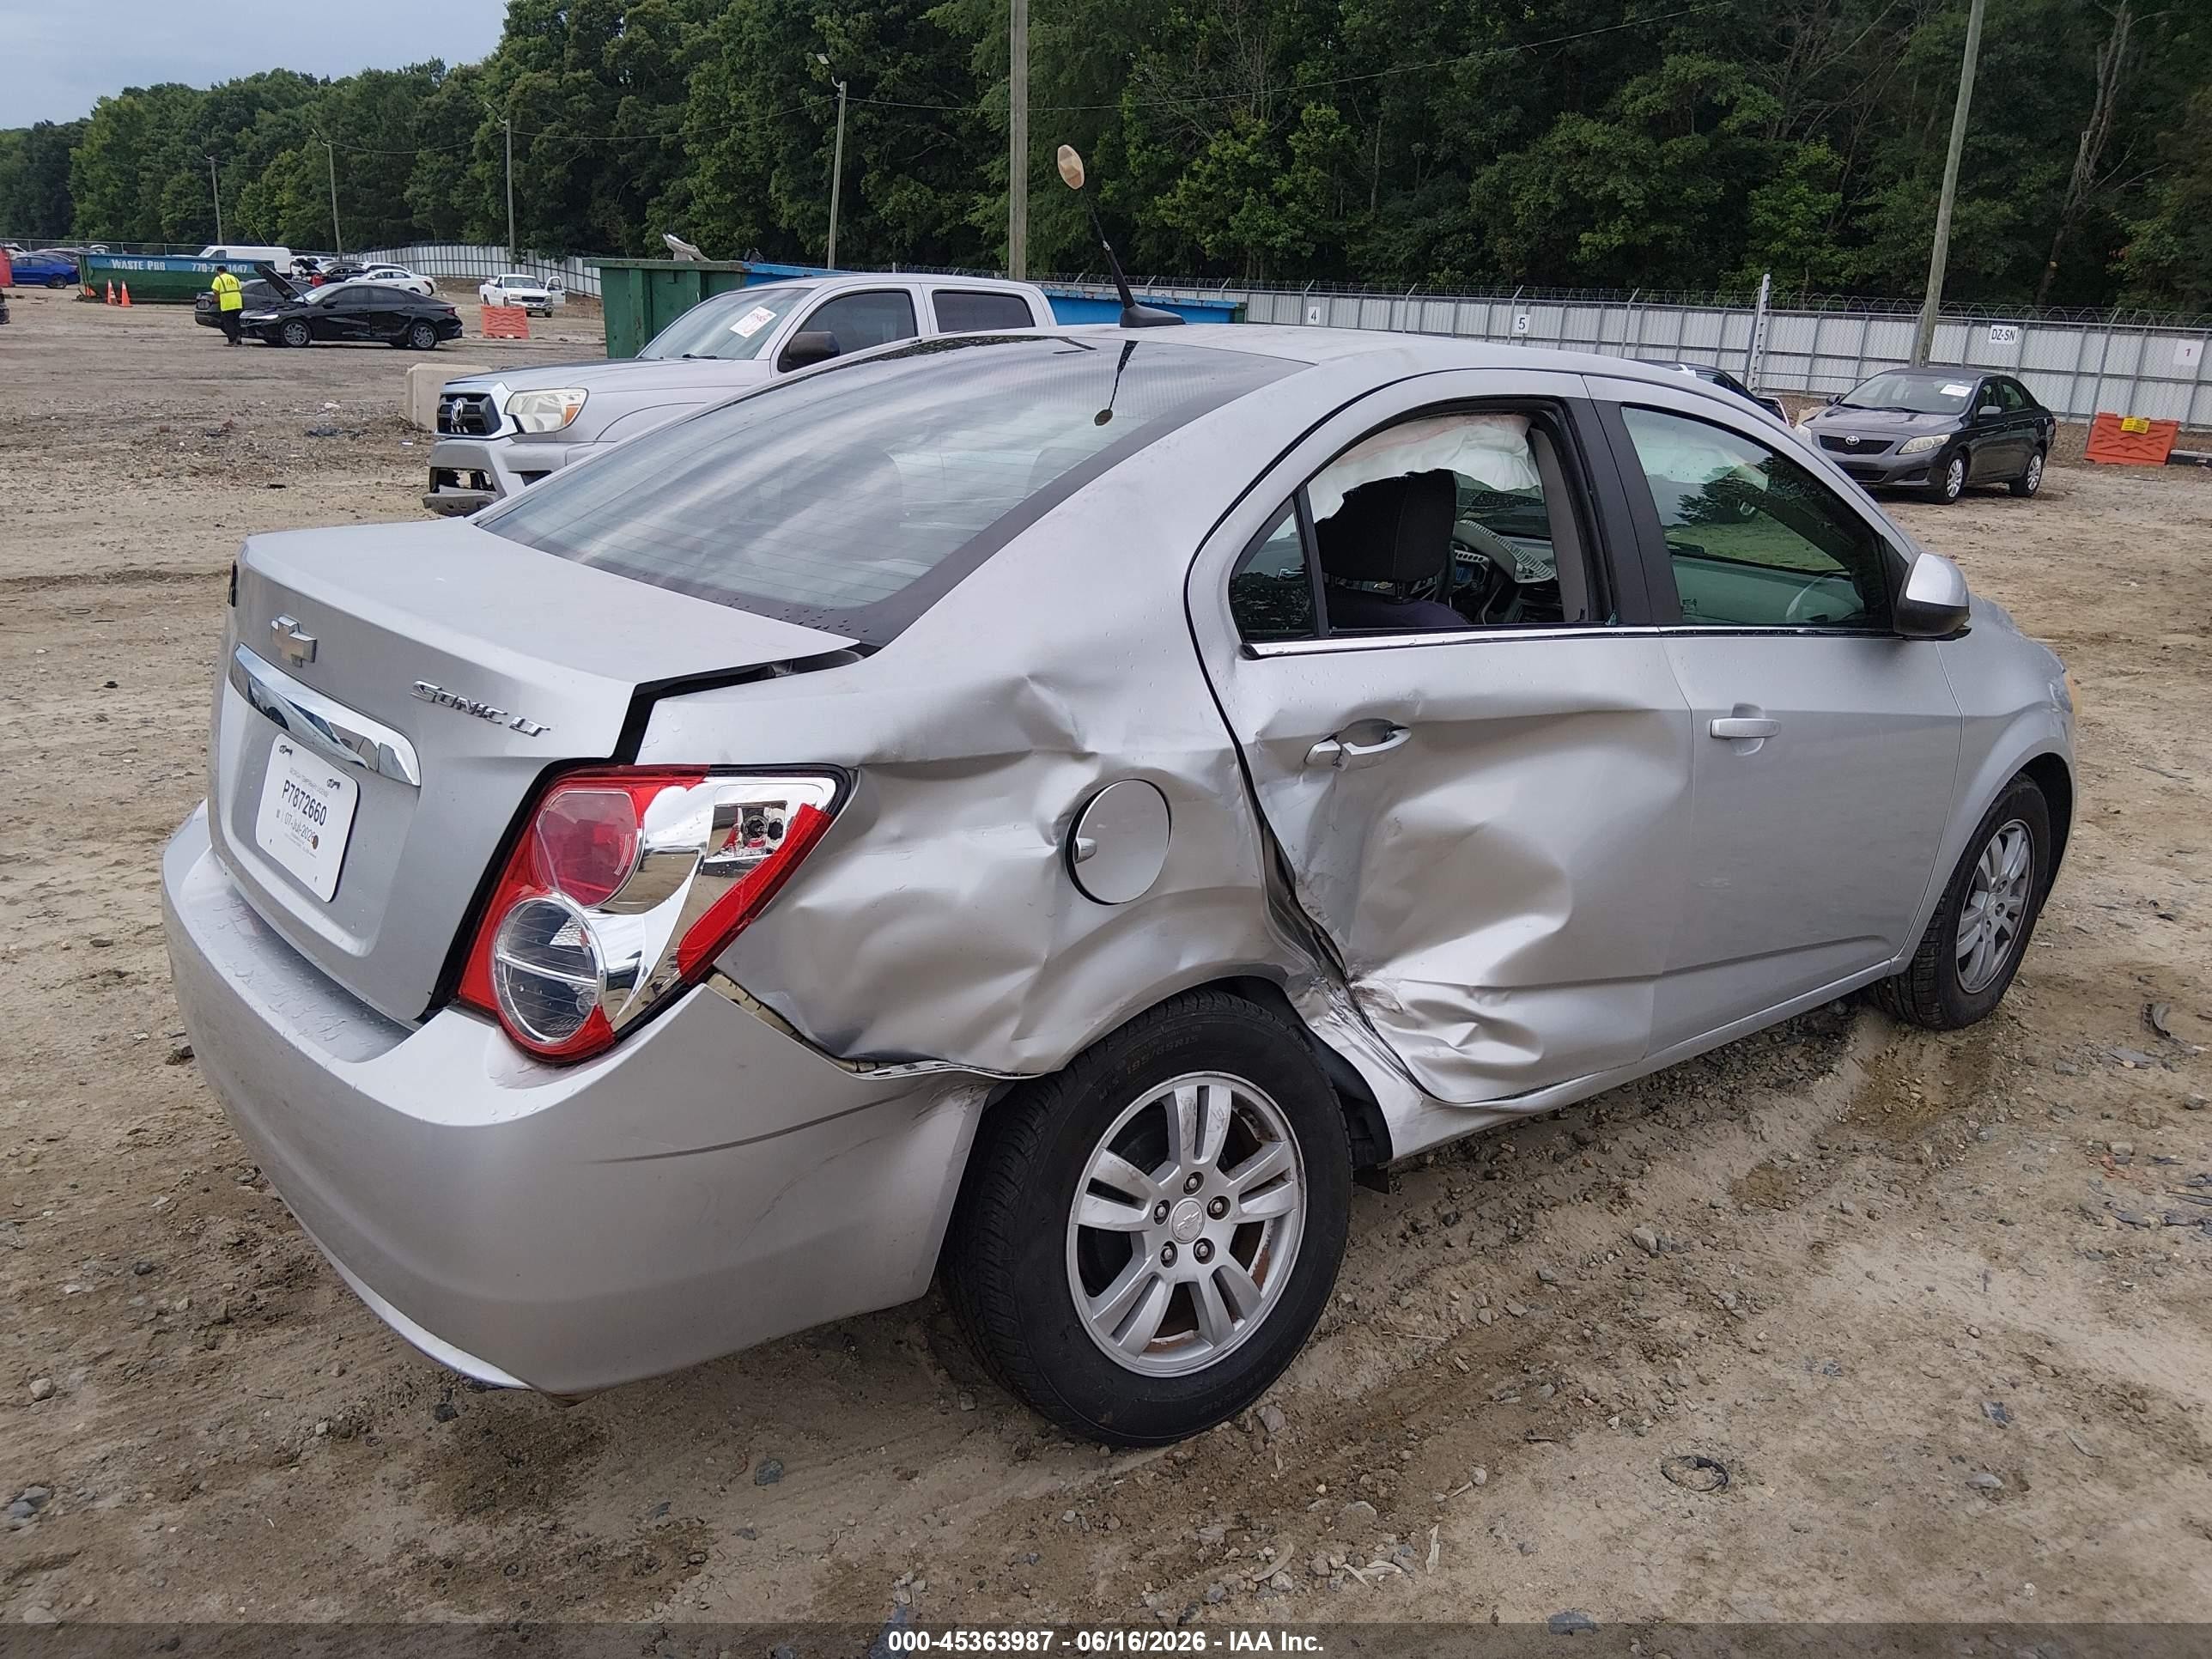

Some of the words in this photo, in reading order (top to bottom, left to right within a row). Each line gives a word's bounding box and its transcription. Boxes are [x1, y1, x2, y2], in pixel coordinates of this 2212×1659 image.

[112, 259, 144, 270] WASTE
[1311, 310, 1317, 321] 4
[1518, 318, 1525, 331] 5
[1991, 329, 2015, 341] DZ-SN
[2185, 348, 2191, 357] 1
[409, 679, 508, 725] SONIC
[509, 716, 551, 738] LT
[281, 779, 327, 827] P7872660
